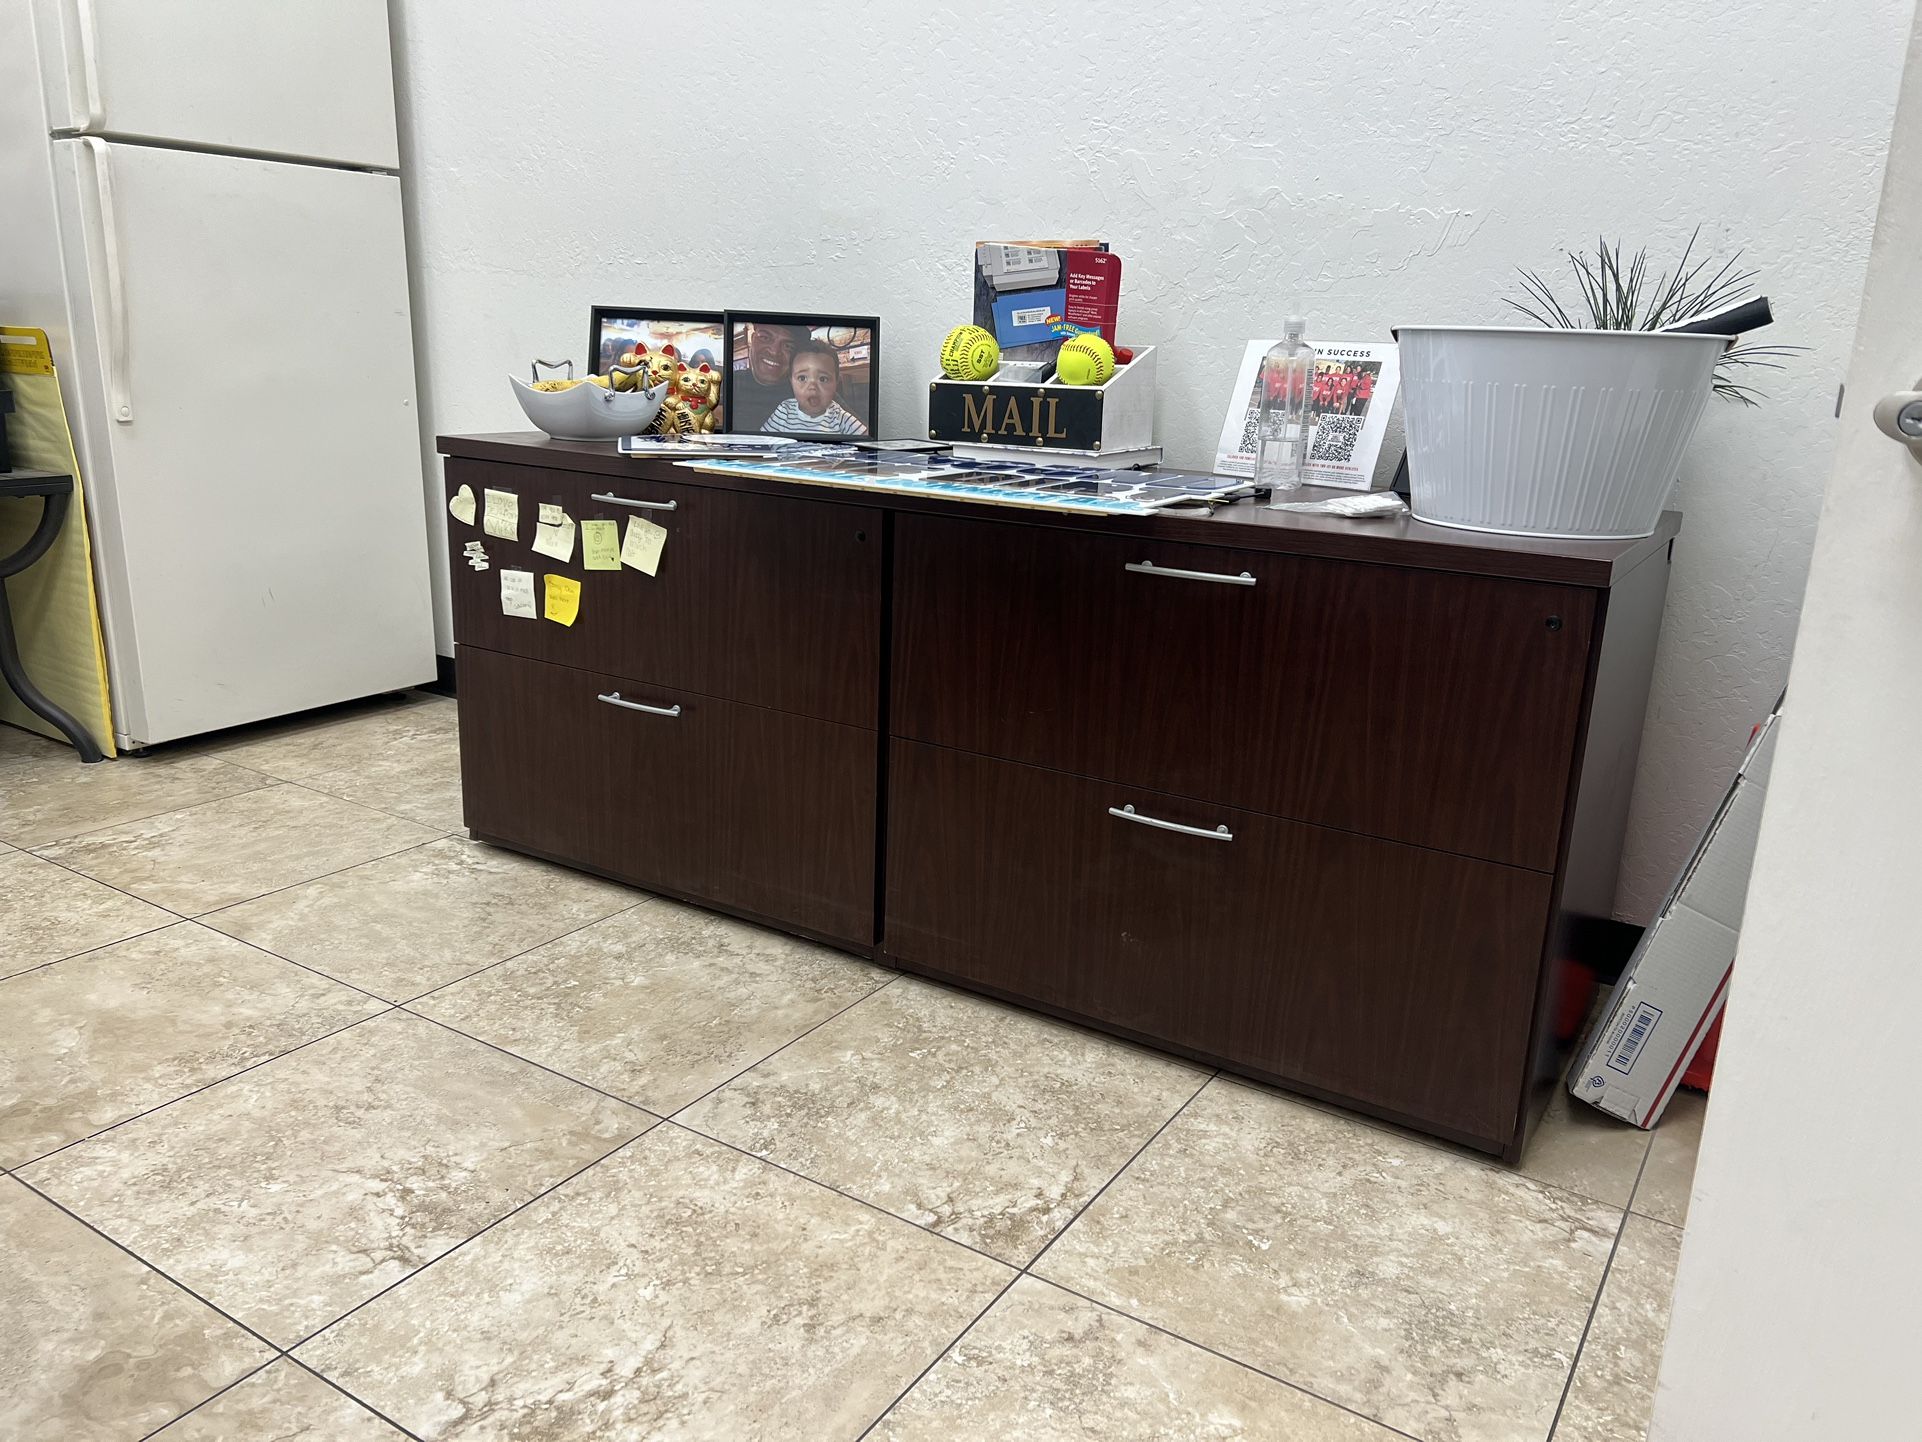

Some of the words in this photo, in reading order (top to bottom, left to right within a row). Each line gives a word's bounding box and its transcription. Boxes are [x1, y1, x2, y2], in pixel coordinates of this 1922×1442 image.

[1086, 274, 1105, 282] Messages
[1327, 348, 1372, 358] SUCCESS
[961, 393, 1067, 439] MAIL
